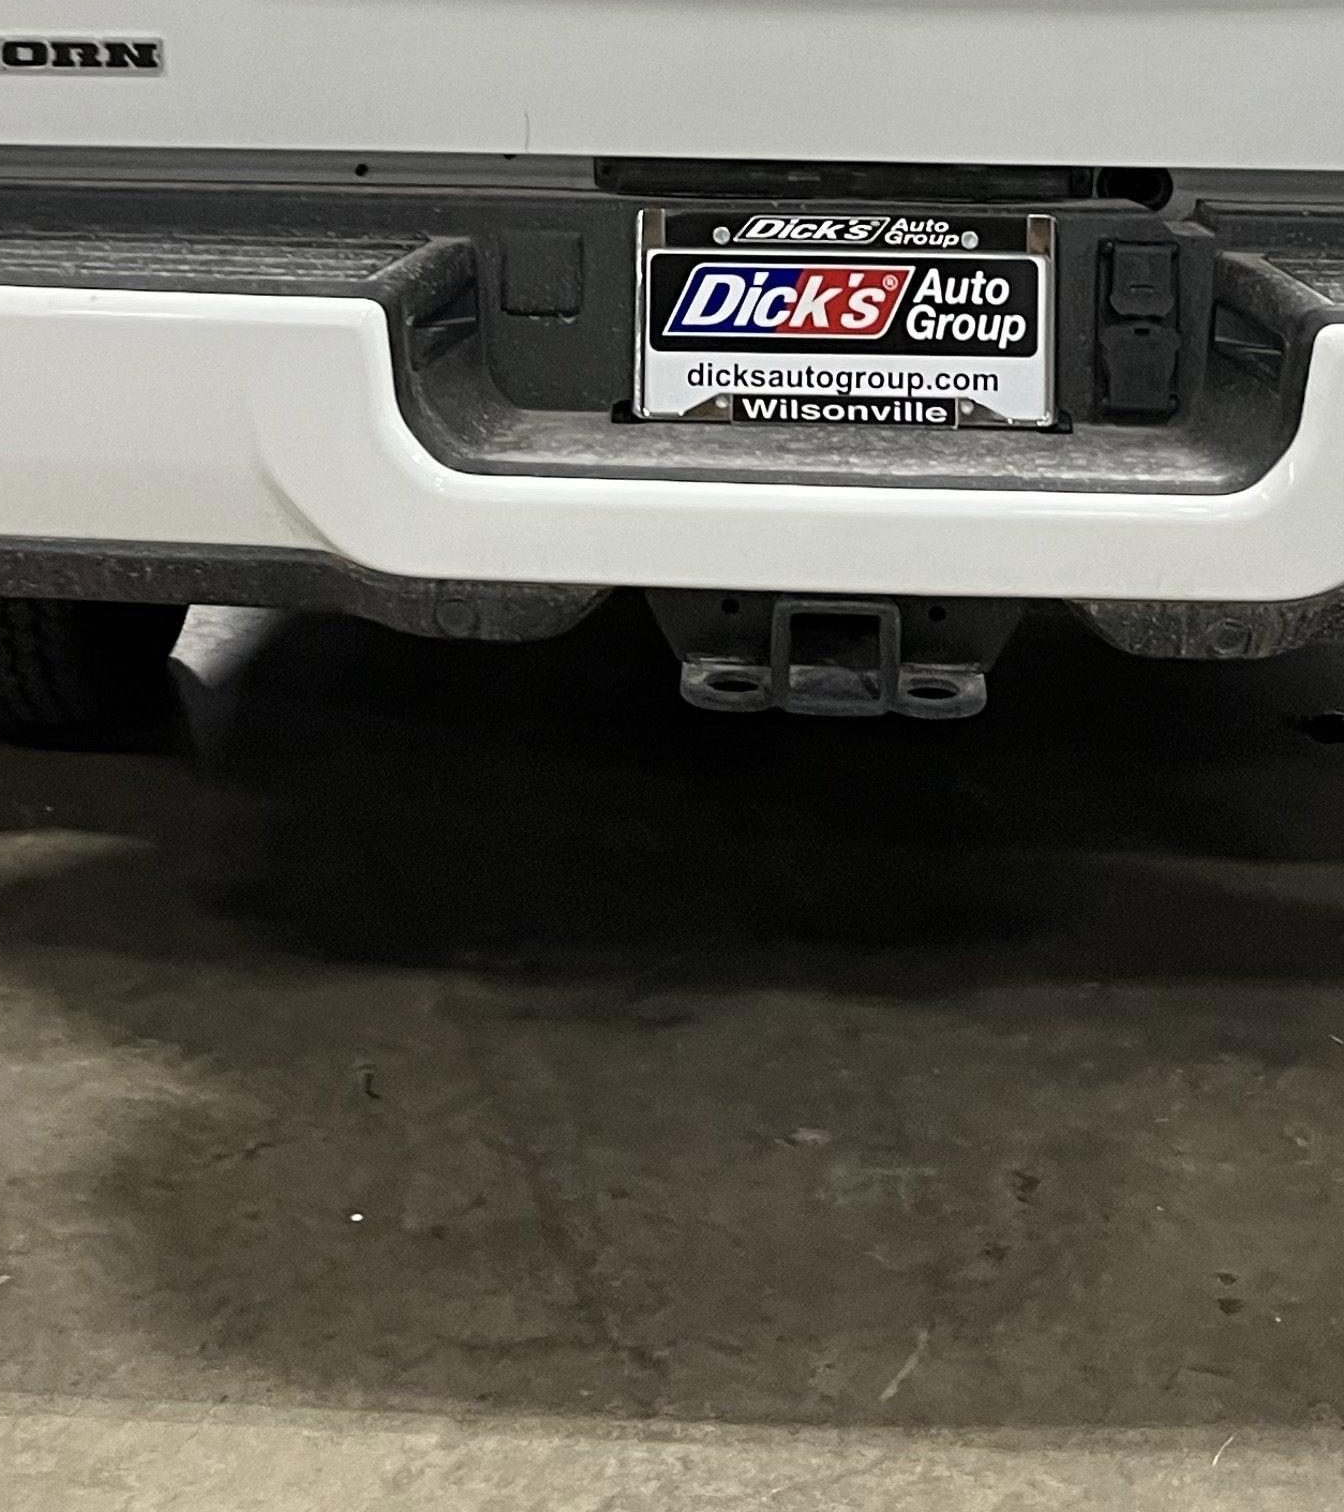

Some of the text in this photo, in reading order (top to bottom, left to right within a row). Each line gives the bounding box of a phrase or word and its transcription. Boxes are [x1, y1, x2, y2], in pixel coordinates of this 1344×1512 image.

[745, 217, 950, 240] Dick's Auto
[884, 230, 960, 248] Group
[681, 268, 1010, 329] Dick's Auto
[906, 305, 1027, 349] Group
[687, 362, 999, 397] dicksautogroup.com
[742, 398, 948, 424] Wilsonville
